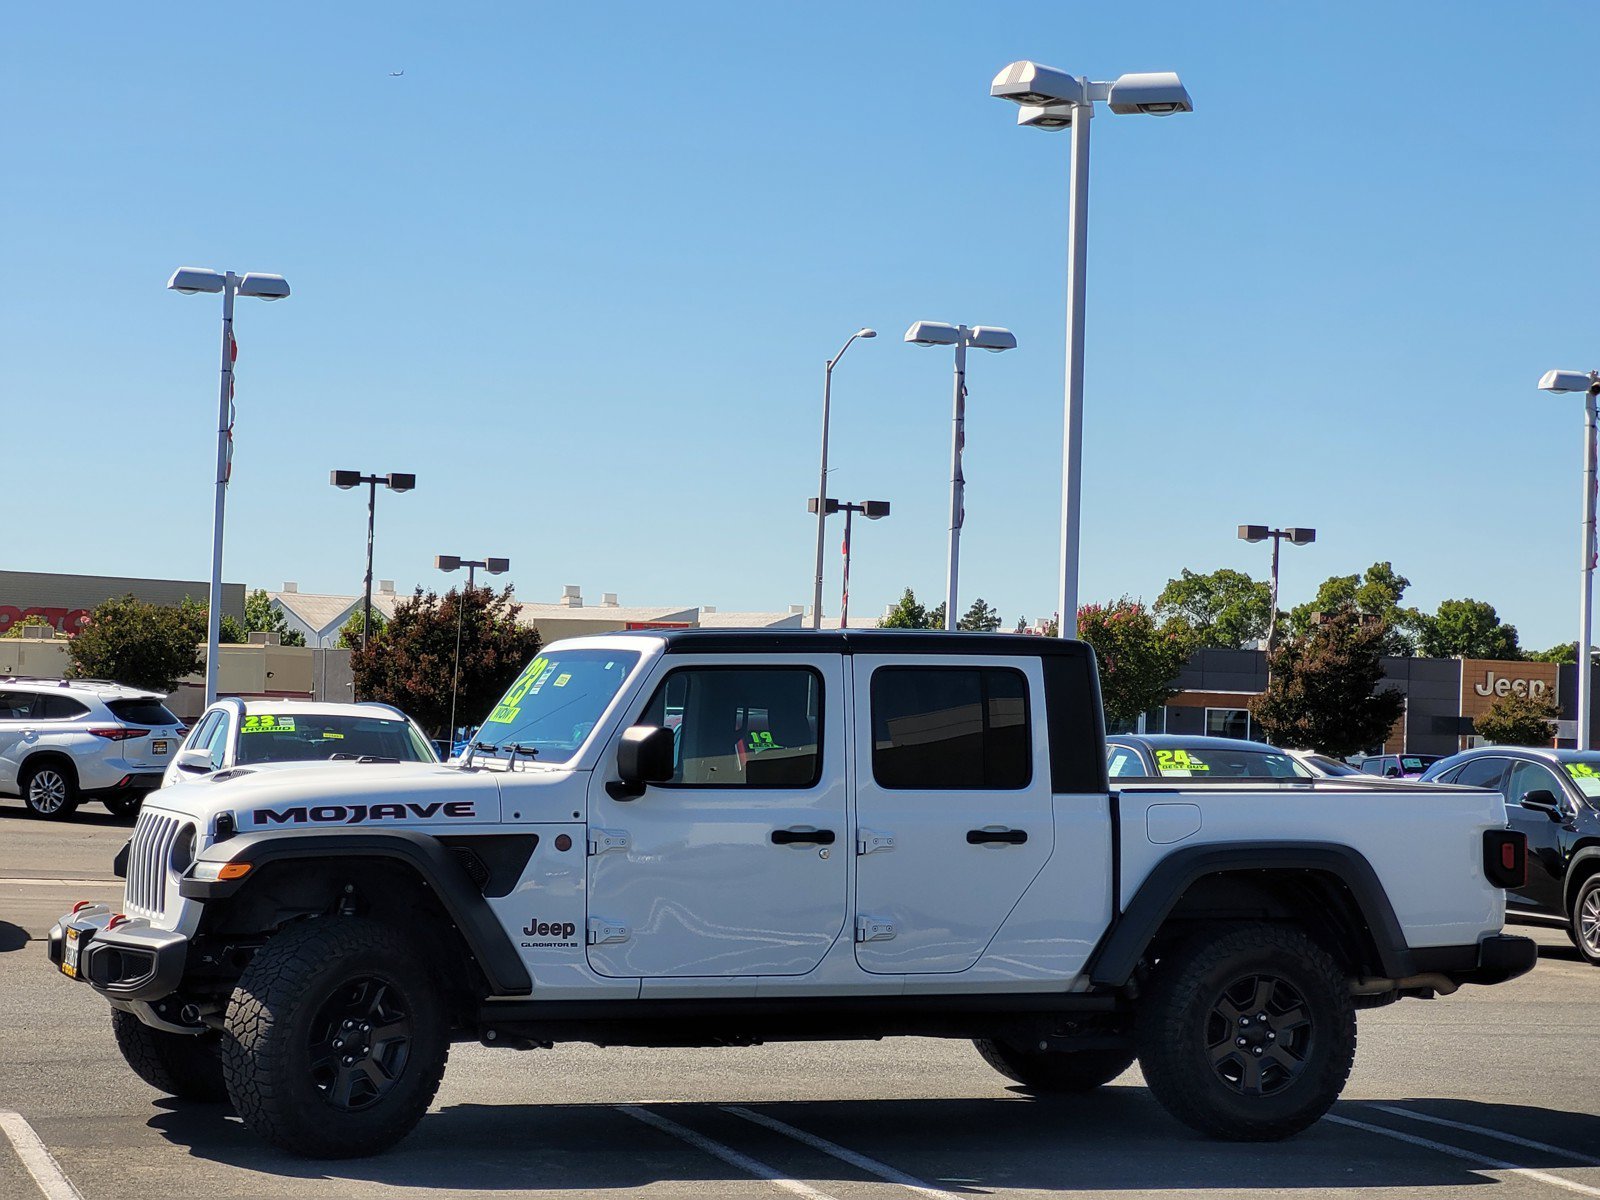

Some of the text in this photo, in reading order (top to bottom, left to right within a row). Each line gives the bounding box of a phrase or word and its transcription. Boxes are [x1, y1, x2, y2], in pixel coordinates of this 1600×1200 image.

[245, 715, 275, 727] 23
[1156, 750, 1190, 765] 24
[1565, 763, 1592, 775] 16
[253, 801, 476, 825] MOJAVE
[523, 918, 576, 940] Jeep
